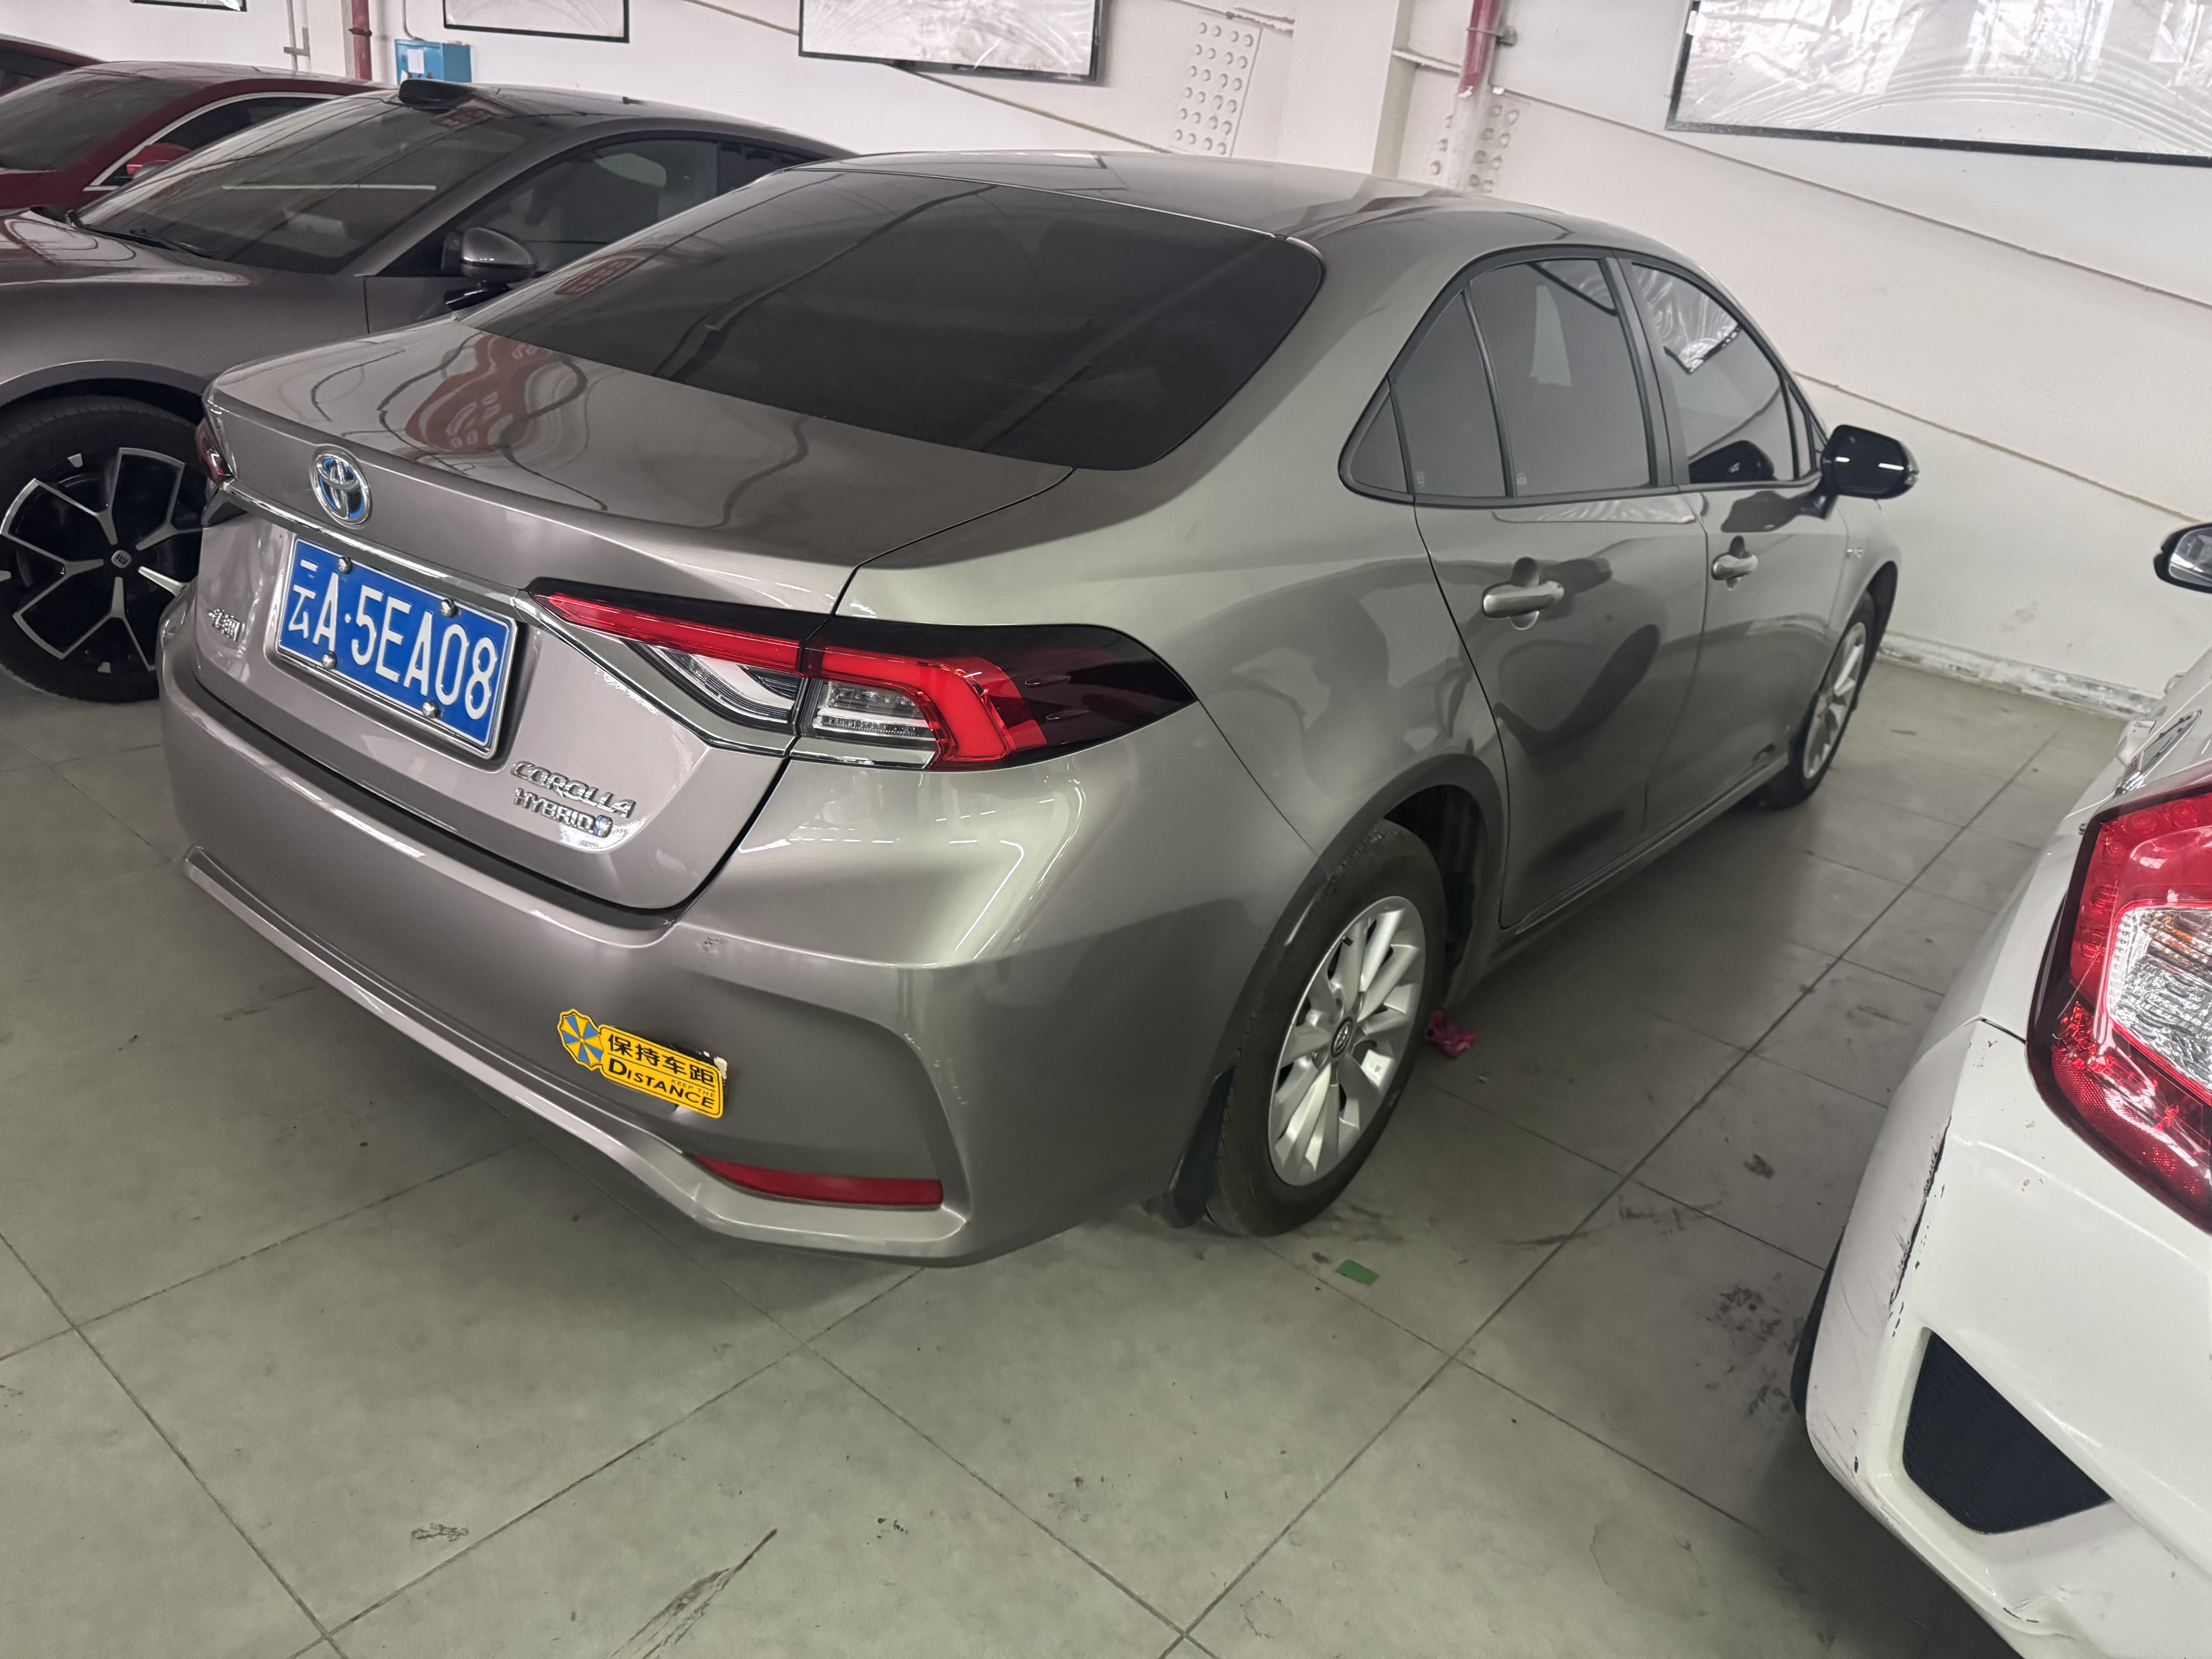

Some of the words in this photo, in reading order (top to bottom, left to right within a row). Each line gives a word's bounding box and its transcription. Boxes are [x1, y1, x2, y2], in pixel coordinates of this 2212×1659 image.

[511, 761, 636, 818] COROLLA
[514, 788, 596, 833] HYBRID
[608, 1034, 715, 1088] 保持车距
[608, 1058, 715, 1109] DISTANCE
[671, 1079, 694, 1089] KEEP
[697, 1089, 715, 1099] THE
